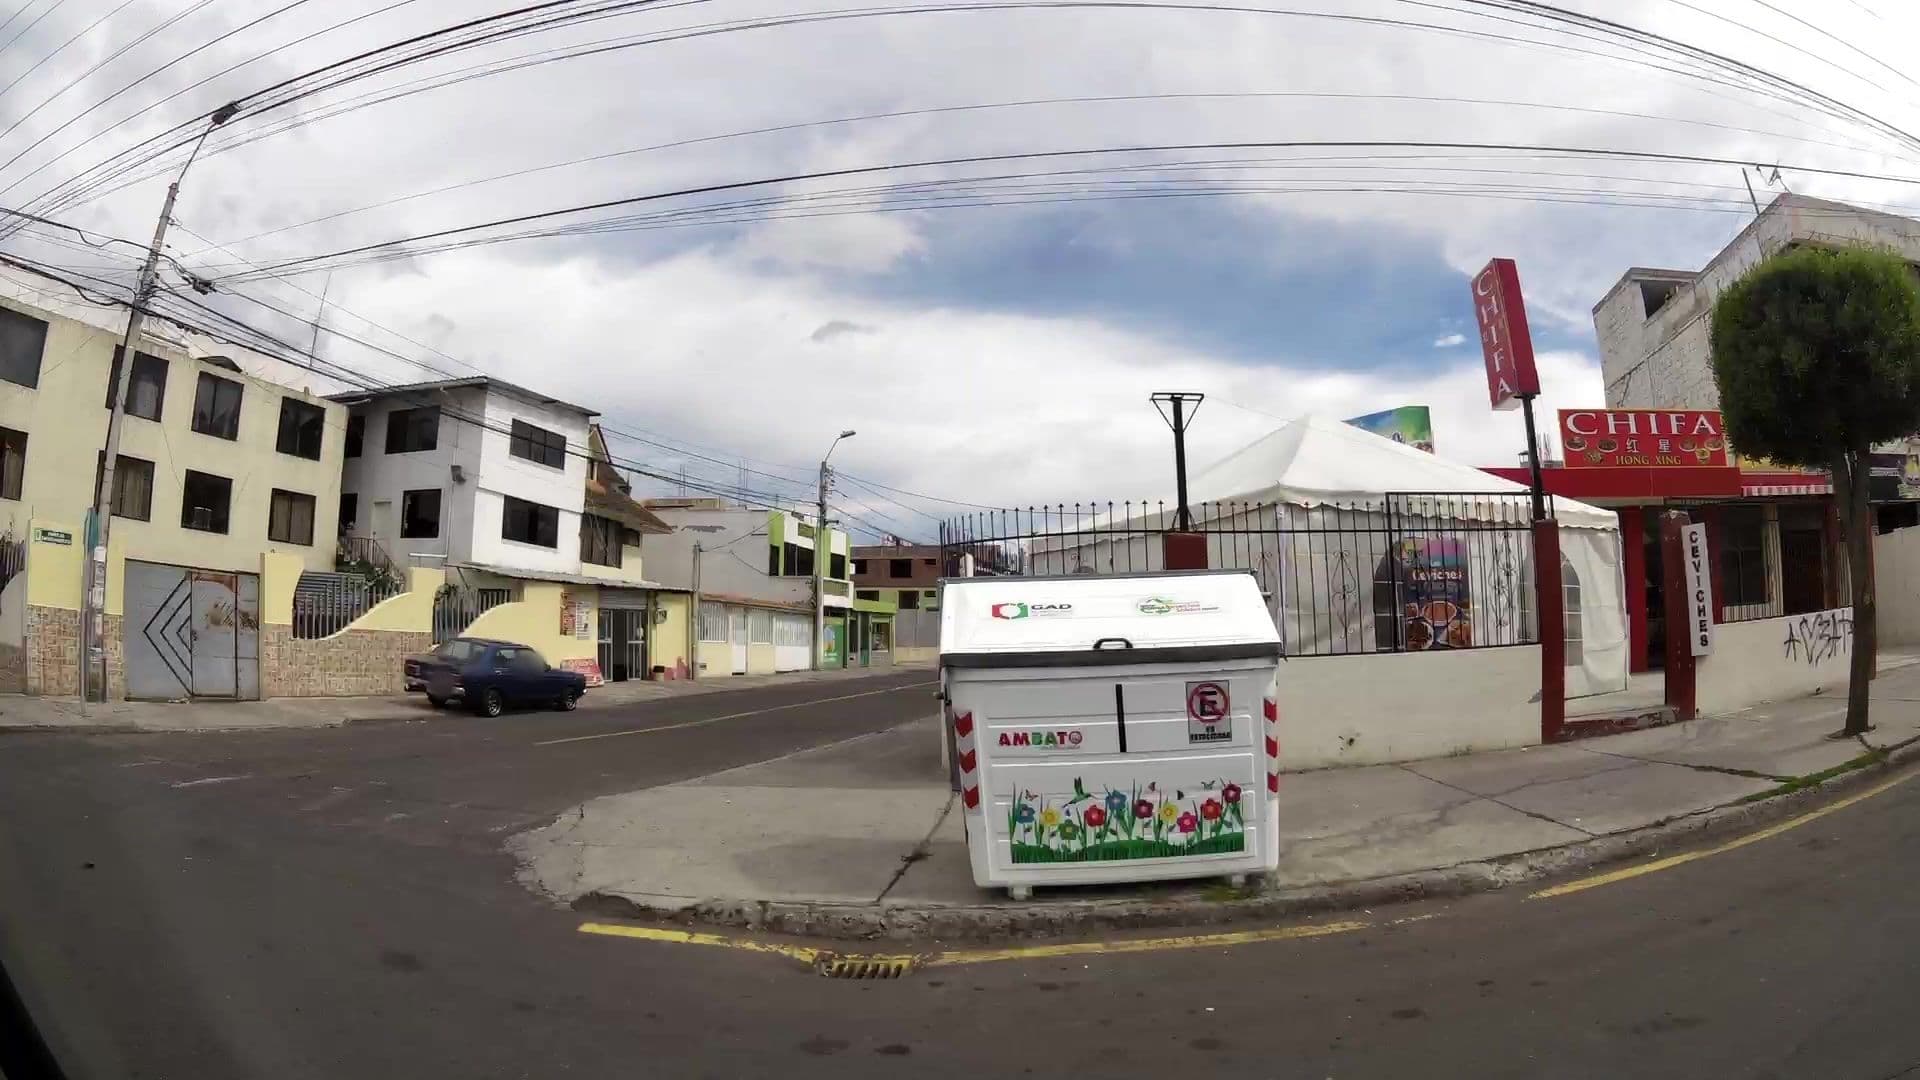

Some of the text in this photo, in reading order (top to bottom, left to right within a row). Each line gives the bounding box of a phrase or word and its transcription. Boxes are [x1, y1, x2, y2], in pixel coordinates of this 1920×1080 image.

[1476, 269, 1512, 401] CHIFA
[1566, 412, 1717, 435] CHIFA
[1615, 455, 1682, 465] HONG XING
[1689, 530, 1709, 647] CEVICHES
[998, 730, 1083, 746] AMBATO
